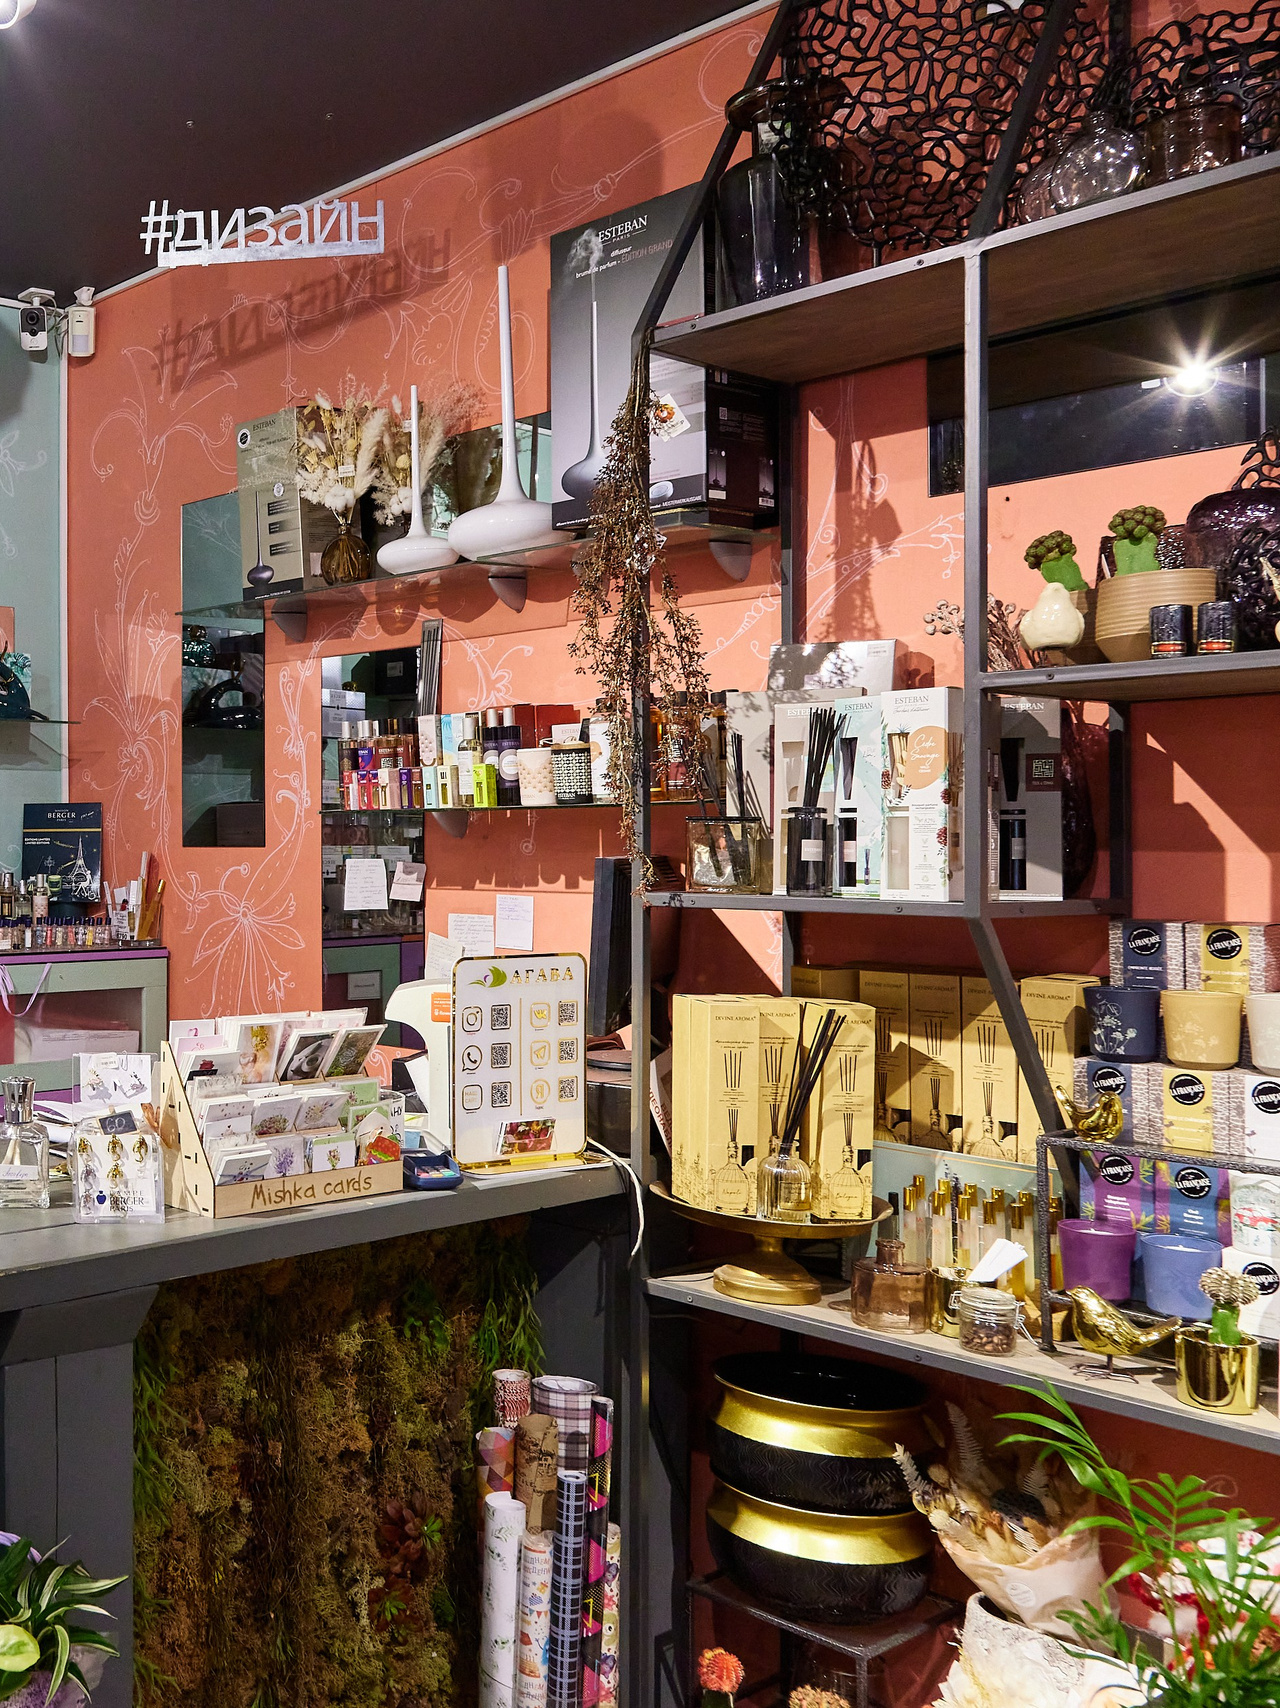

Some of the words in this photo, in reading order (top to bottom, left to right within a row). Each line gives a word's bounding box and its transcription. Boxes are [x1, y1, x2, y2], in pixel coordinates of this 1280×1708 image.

[140, 199, 384, 267] #дизайн
[598, 214, 648, 243] ESTEBAN
[612, 233, 631, 243] PARIS
[599, 259, 617, 273] parfum
[252, 418, 277, 432] ESTEBAN
[894, 695, 929, 704] ESTEBAN
[1004, 702, 1044, 710] ESTEBAN
[844, 702, 873, 711] ESTEBAN
[1128, 941, 1135, 949] LA
[1134, 935, 1162, 948] FRANÇAISE
[1207, 943, 1214, 952] LA
[1213, 938, 1242, 951] FRANÇAISE
[509, 966, 574, 985] АГАВА
[1026, 992, 1046, 1000] DIVINE
[1093, 1081, 1100, 1089] LA
[1099, 1075, 1127, 1088] FRANÇAISE
[1170, 1089, 1177, 1097] LA
[1176, 1084, 1205, 1096] FRANÇAISE
[1252, 1096, 1260, 1104] LA
[1101, 1168, 1108, 1176] LA
[1107, 1164, 1134, 1176] FRANÇAISE
[250, 1180, 316, 1209] Mishka
[323, 1170, 372, 1197] cards
[1175, 1181, 1183, 1189] LA
[1182, 1178, 1211, 1190] FRANÇAISE
[109, 1197, 144, 1205] BERGER
